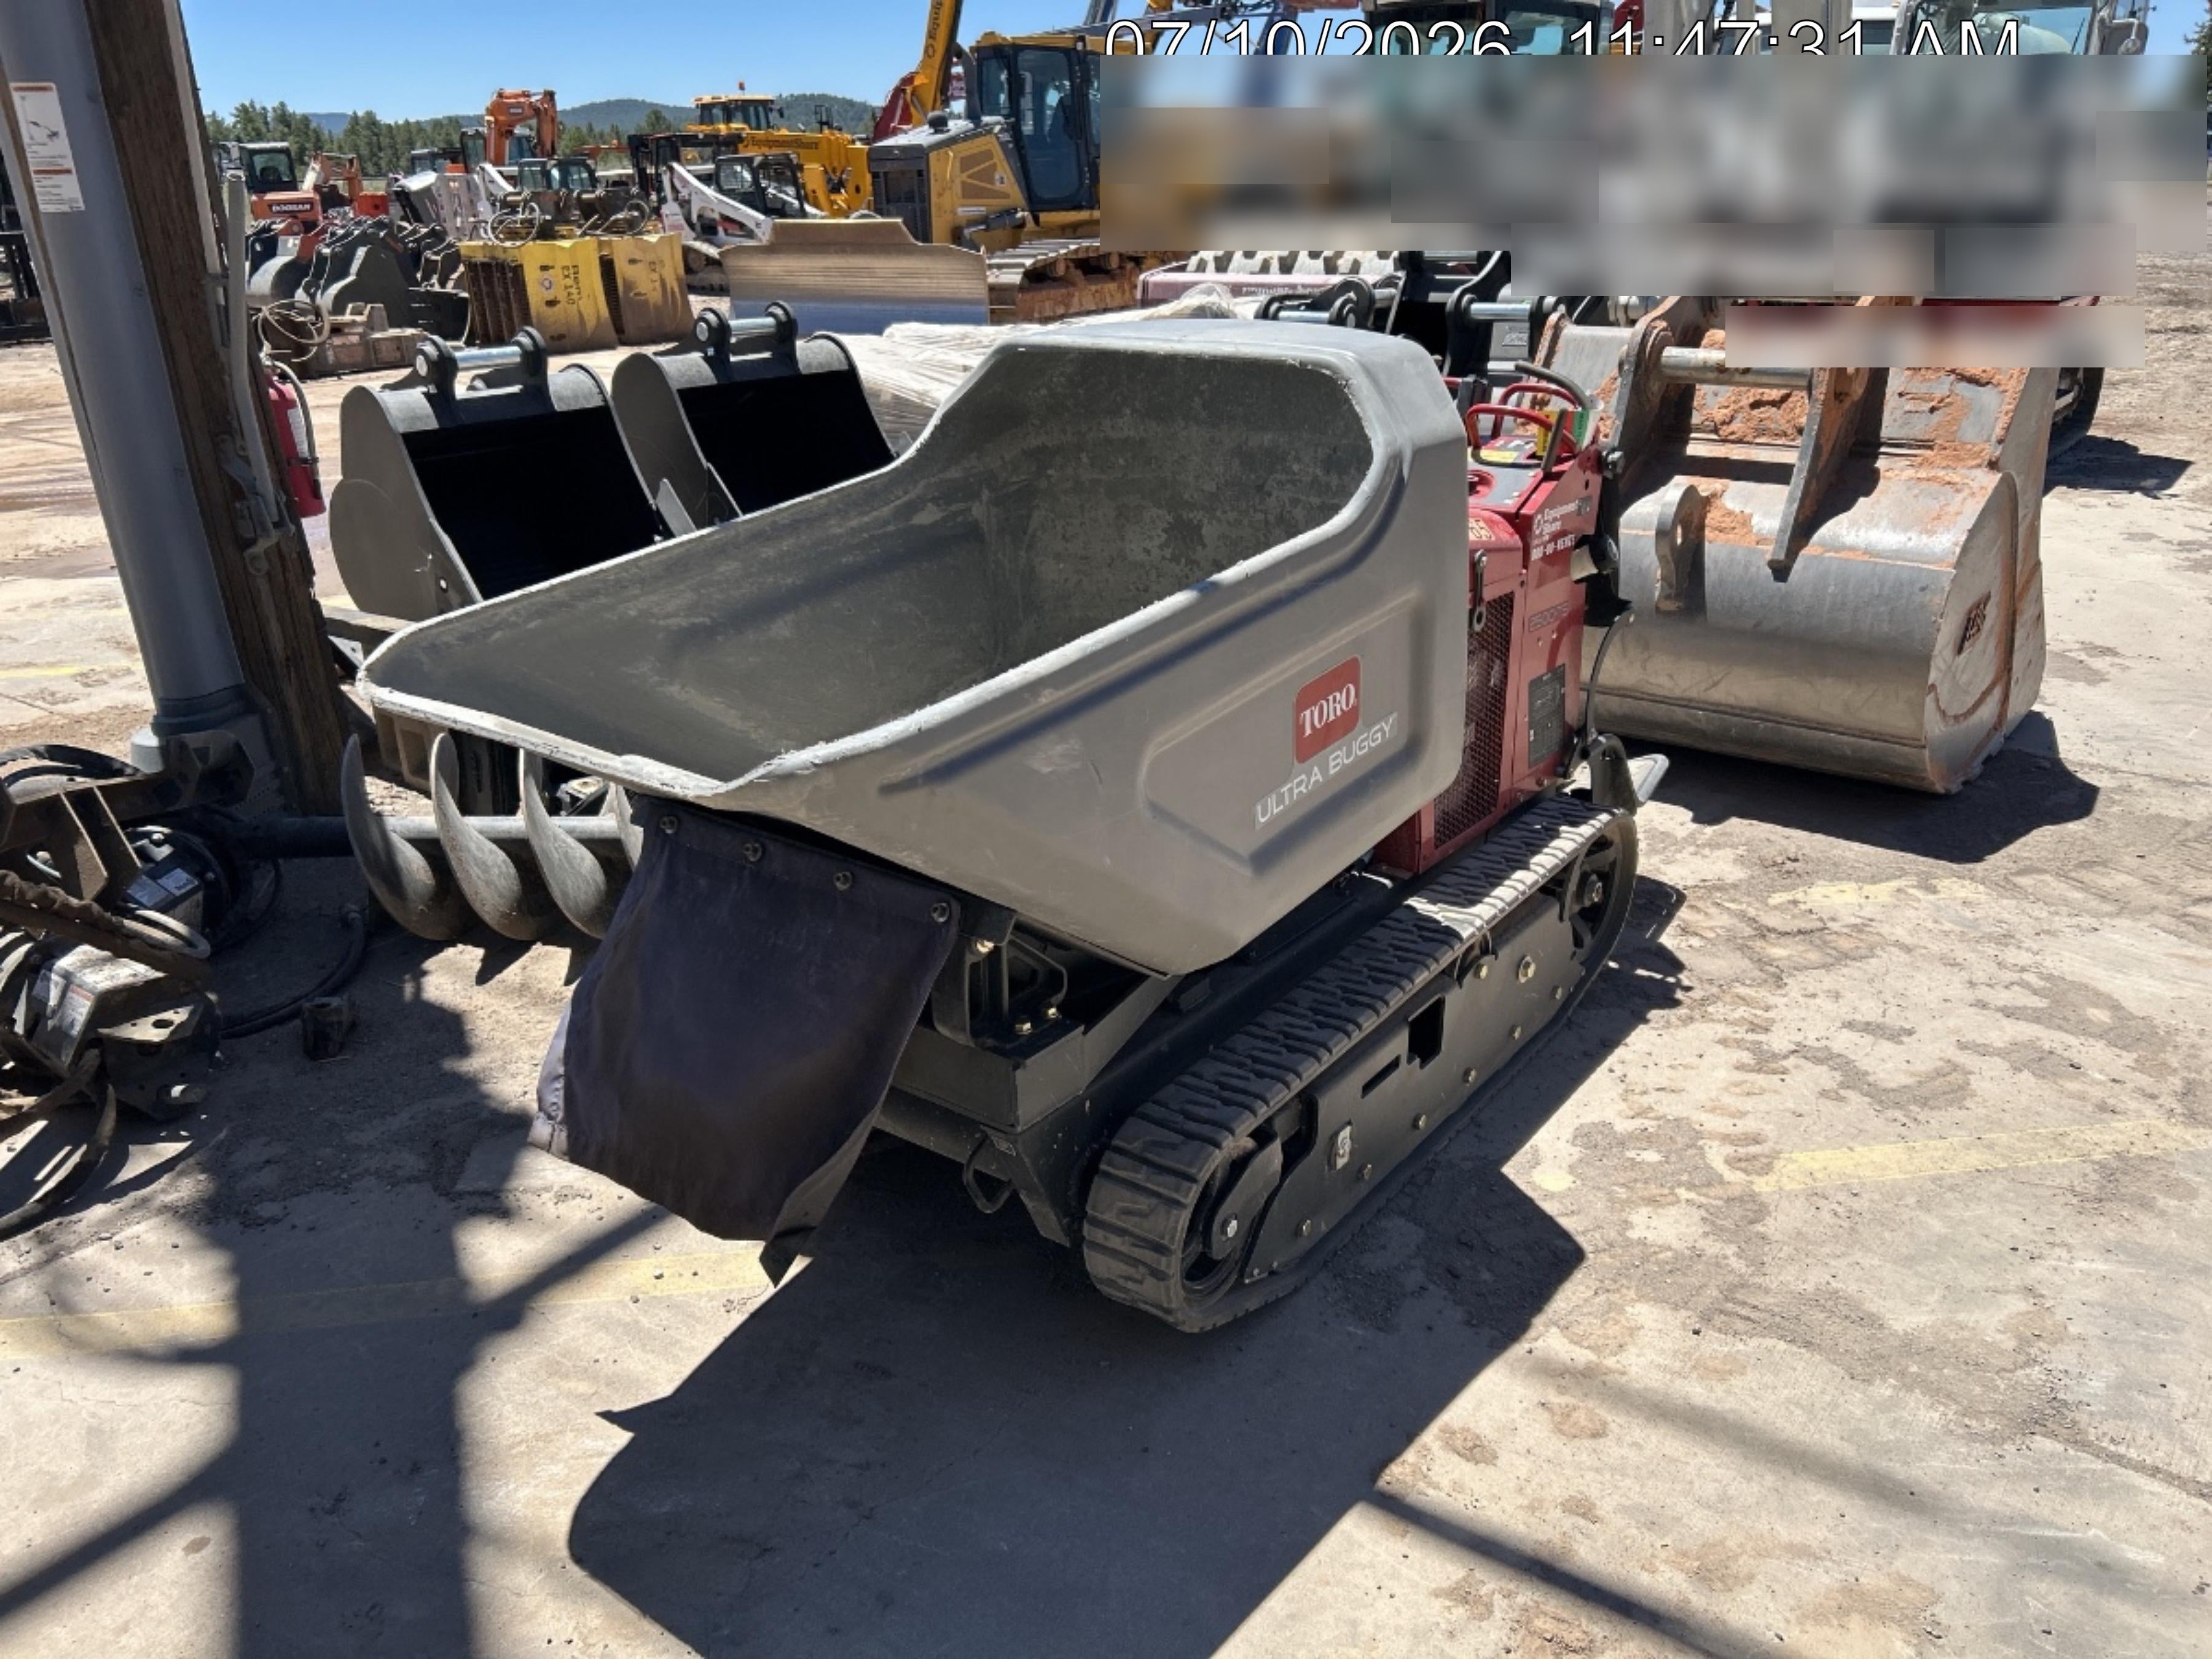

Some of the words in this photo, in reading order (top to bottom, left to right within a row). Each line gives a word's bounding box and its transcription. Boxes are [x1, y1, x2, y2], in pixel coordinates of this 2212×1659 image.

[1300, 683, 1356, 737] TORO
[1256, 766, 1322, 823] ULTRA
[1328, 715, 1395, 775] BUGGY
